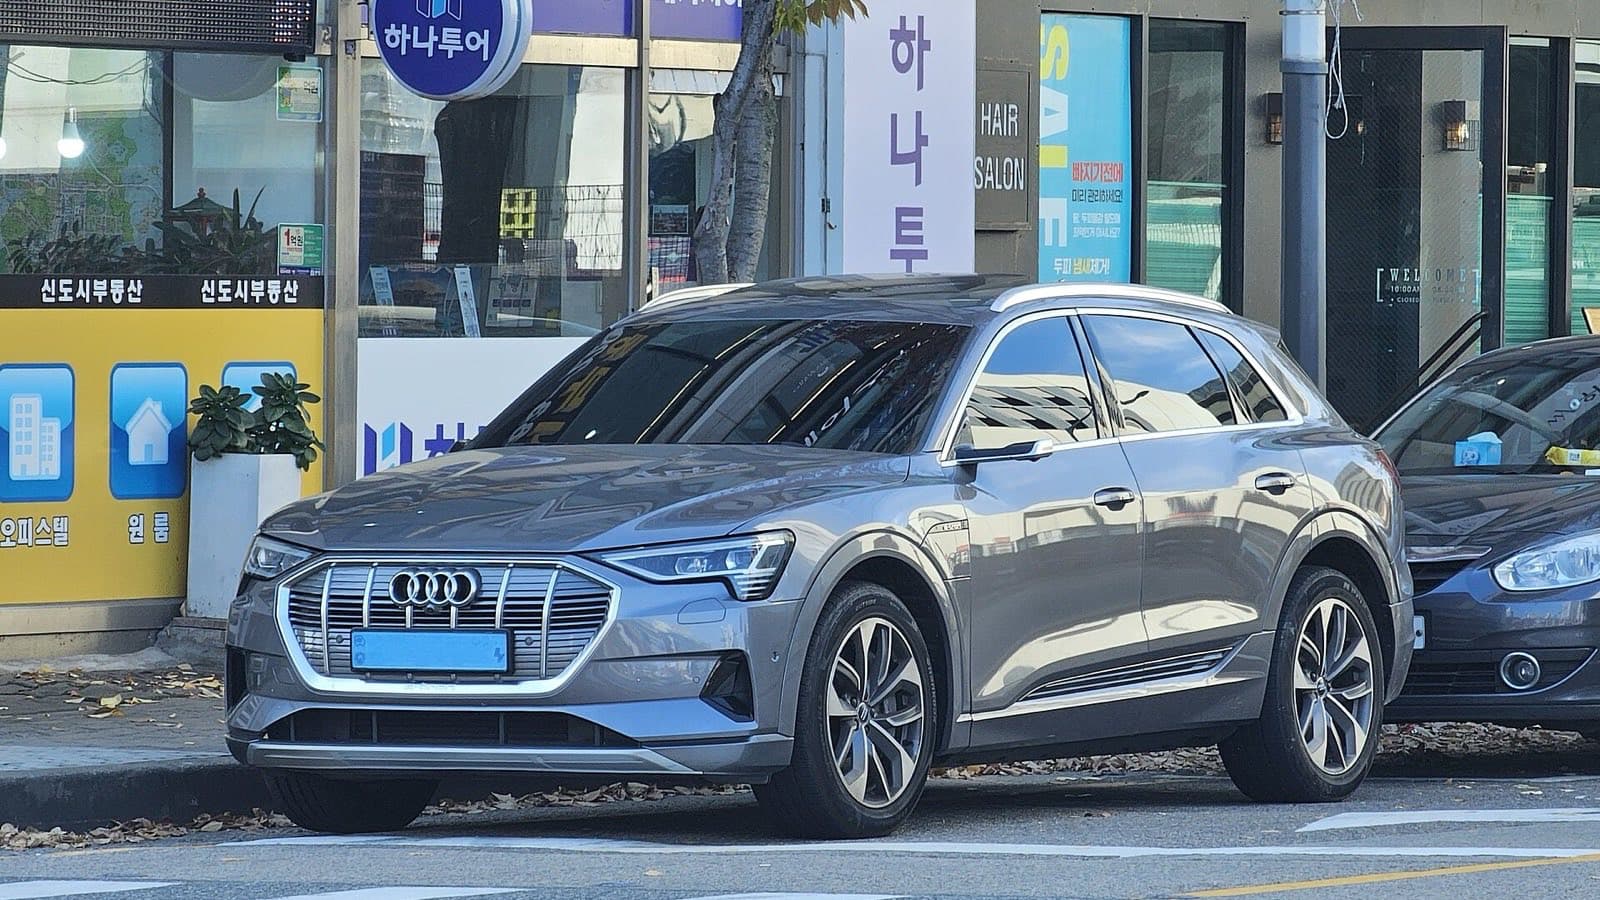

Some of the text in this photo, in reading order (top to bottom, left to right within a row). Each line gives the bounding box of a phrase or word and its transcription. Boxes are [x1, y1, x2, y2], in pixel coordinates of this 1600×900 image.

[384, 23, 490, 62] 하나투어
[981, 102, 1019, 137] HAIR
[974, 155, 1025, 191] SALON
[1072, 162, 1123, 183] 빠지기전에
[1072, 189, 1087, 202] 미리
[1053, 257, 1072, 275] 두피
[1390, 268, 1466, 282] WELCOME
[40, 278, 144, 304] 신도시부동산
[200, 278, 299, 304] 신도시부동산
[0, 515, 70, 548] 오피스텔
